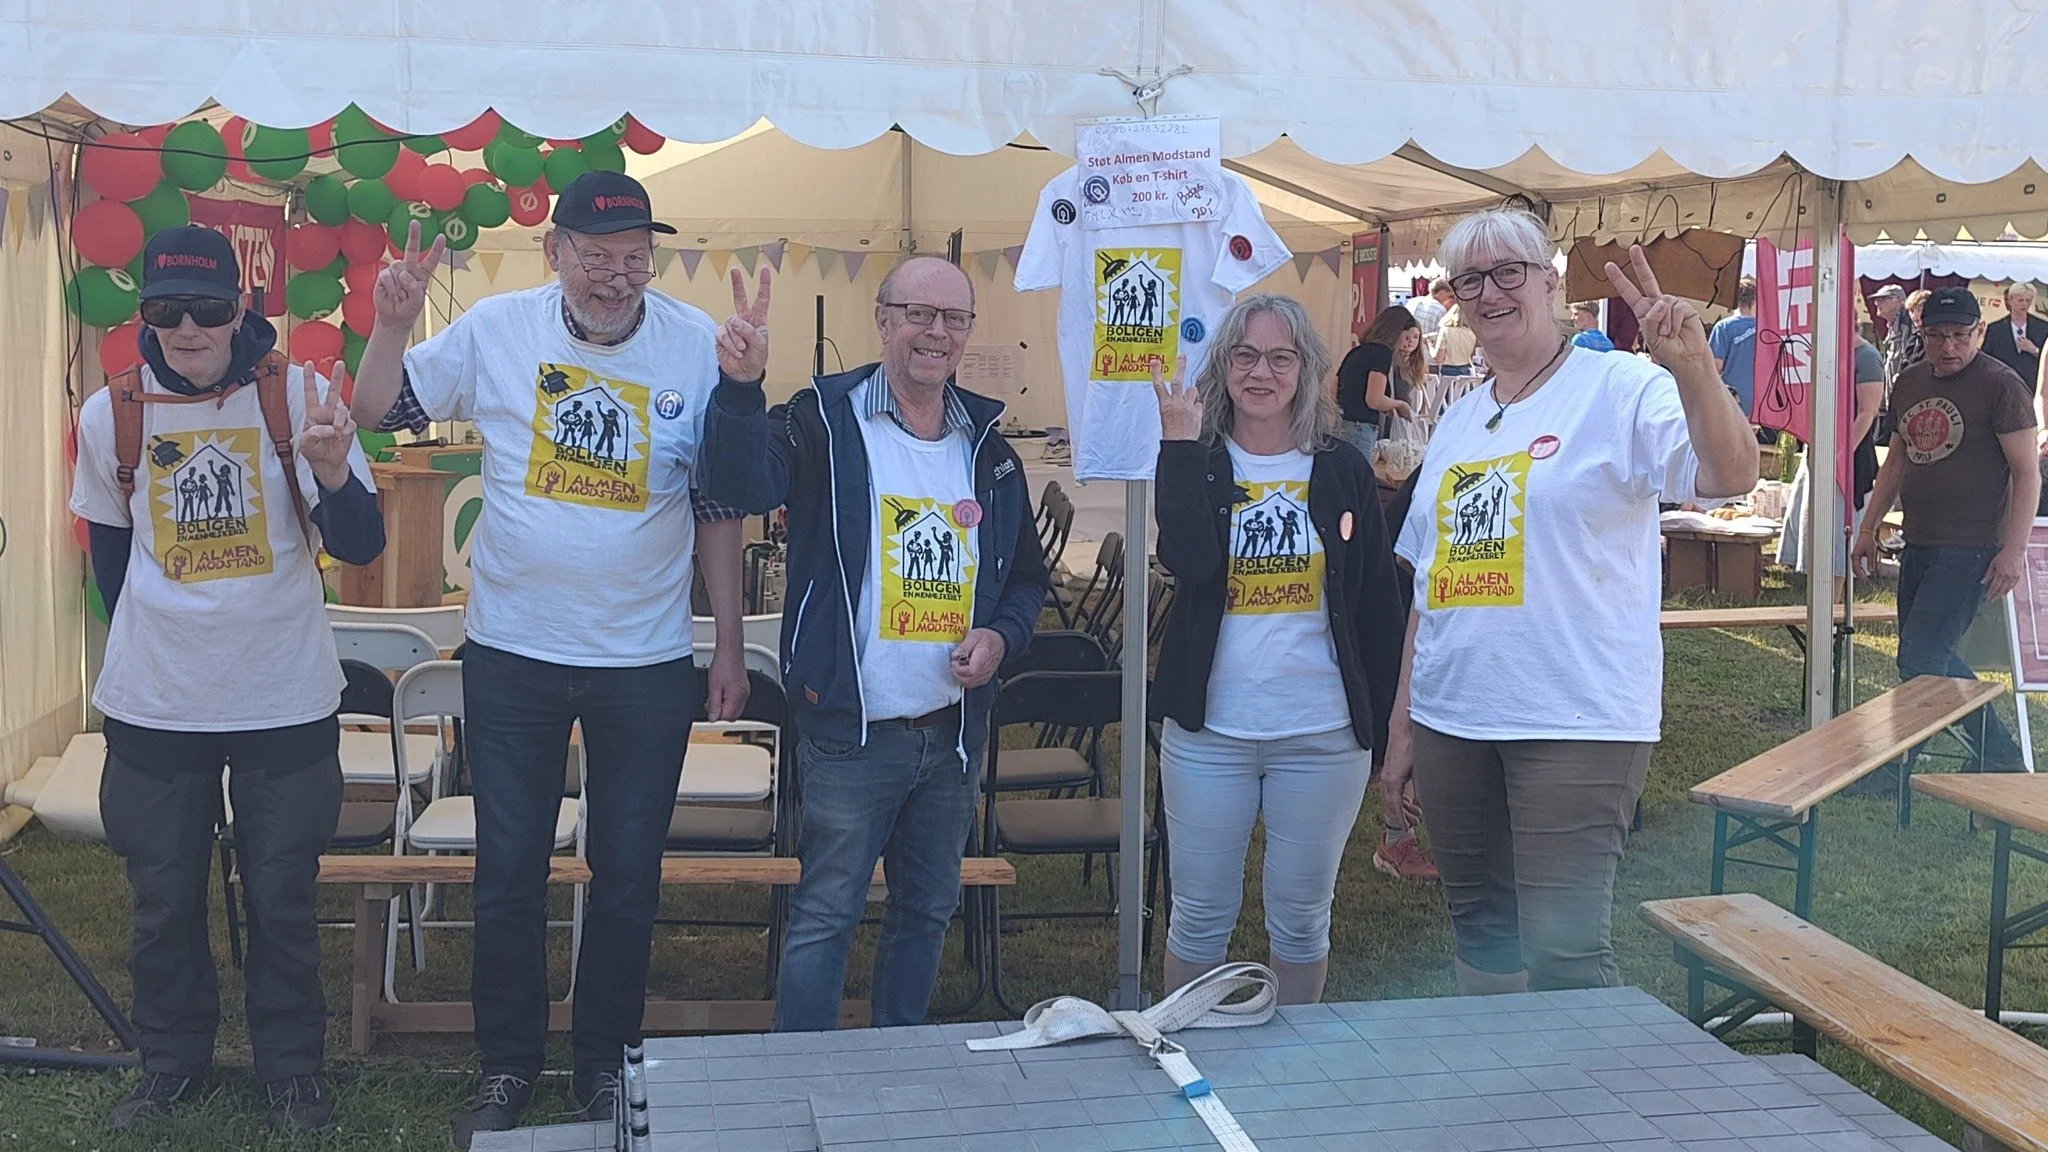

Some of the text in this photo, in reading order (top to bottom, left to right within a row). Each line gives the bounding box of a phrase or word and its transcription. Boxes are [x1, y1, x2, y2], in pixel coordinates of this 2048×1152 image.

[1088, 148, 1211, 167] Støt Almen Modstand
[1112, 170, 1189, 185] Køb en T-shirt
[1132, 191, 1168, 203] 200 kr.
[167, 253, 218, 271] BORNHOLM
[1106, 326, 1163, 338] BOLIGEN
[1117, 362, 1169, 374] MODSTD
[1935, 399, 1962, 426] PAULI
[571, 474, 636, 495] ALMEN
[565, 485, 640, 504] MODSTAND
[177, 519, 247, 535] BOLIGEN
[199, 544, 259, 562] ALMEN
[194, 555, 265, 574] MODSTAND
[1233, 556, 1311, 569] BOLIGEN
[1456, 571, 1509, 586] ALMEN
[903, 580, 961, 594] BOLIGEN
[1251, 583, 1310, 597] ALMEN
[1453, 585, 1515, 597] MODSTAND
[1245, 594, 1314, 607] MODSTAND
[920, 611, 965, 625] ALMEN
